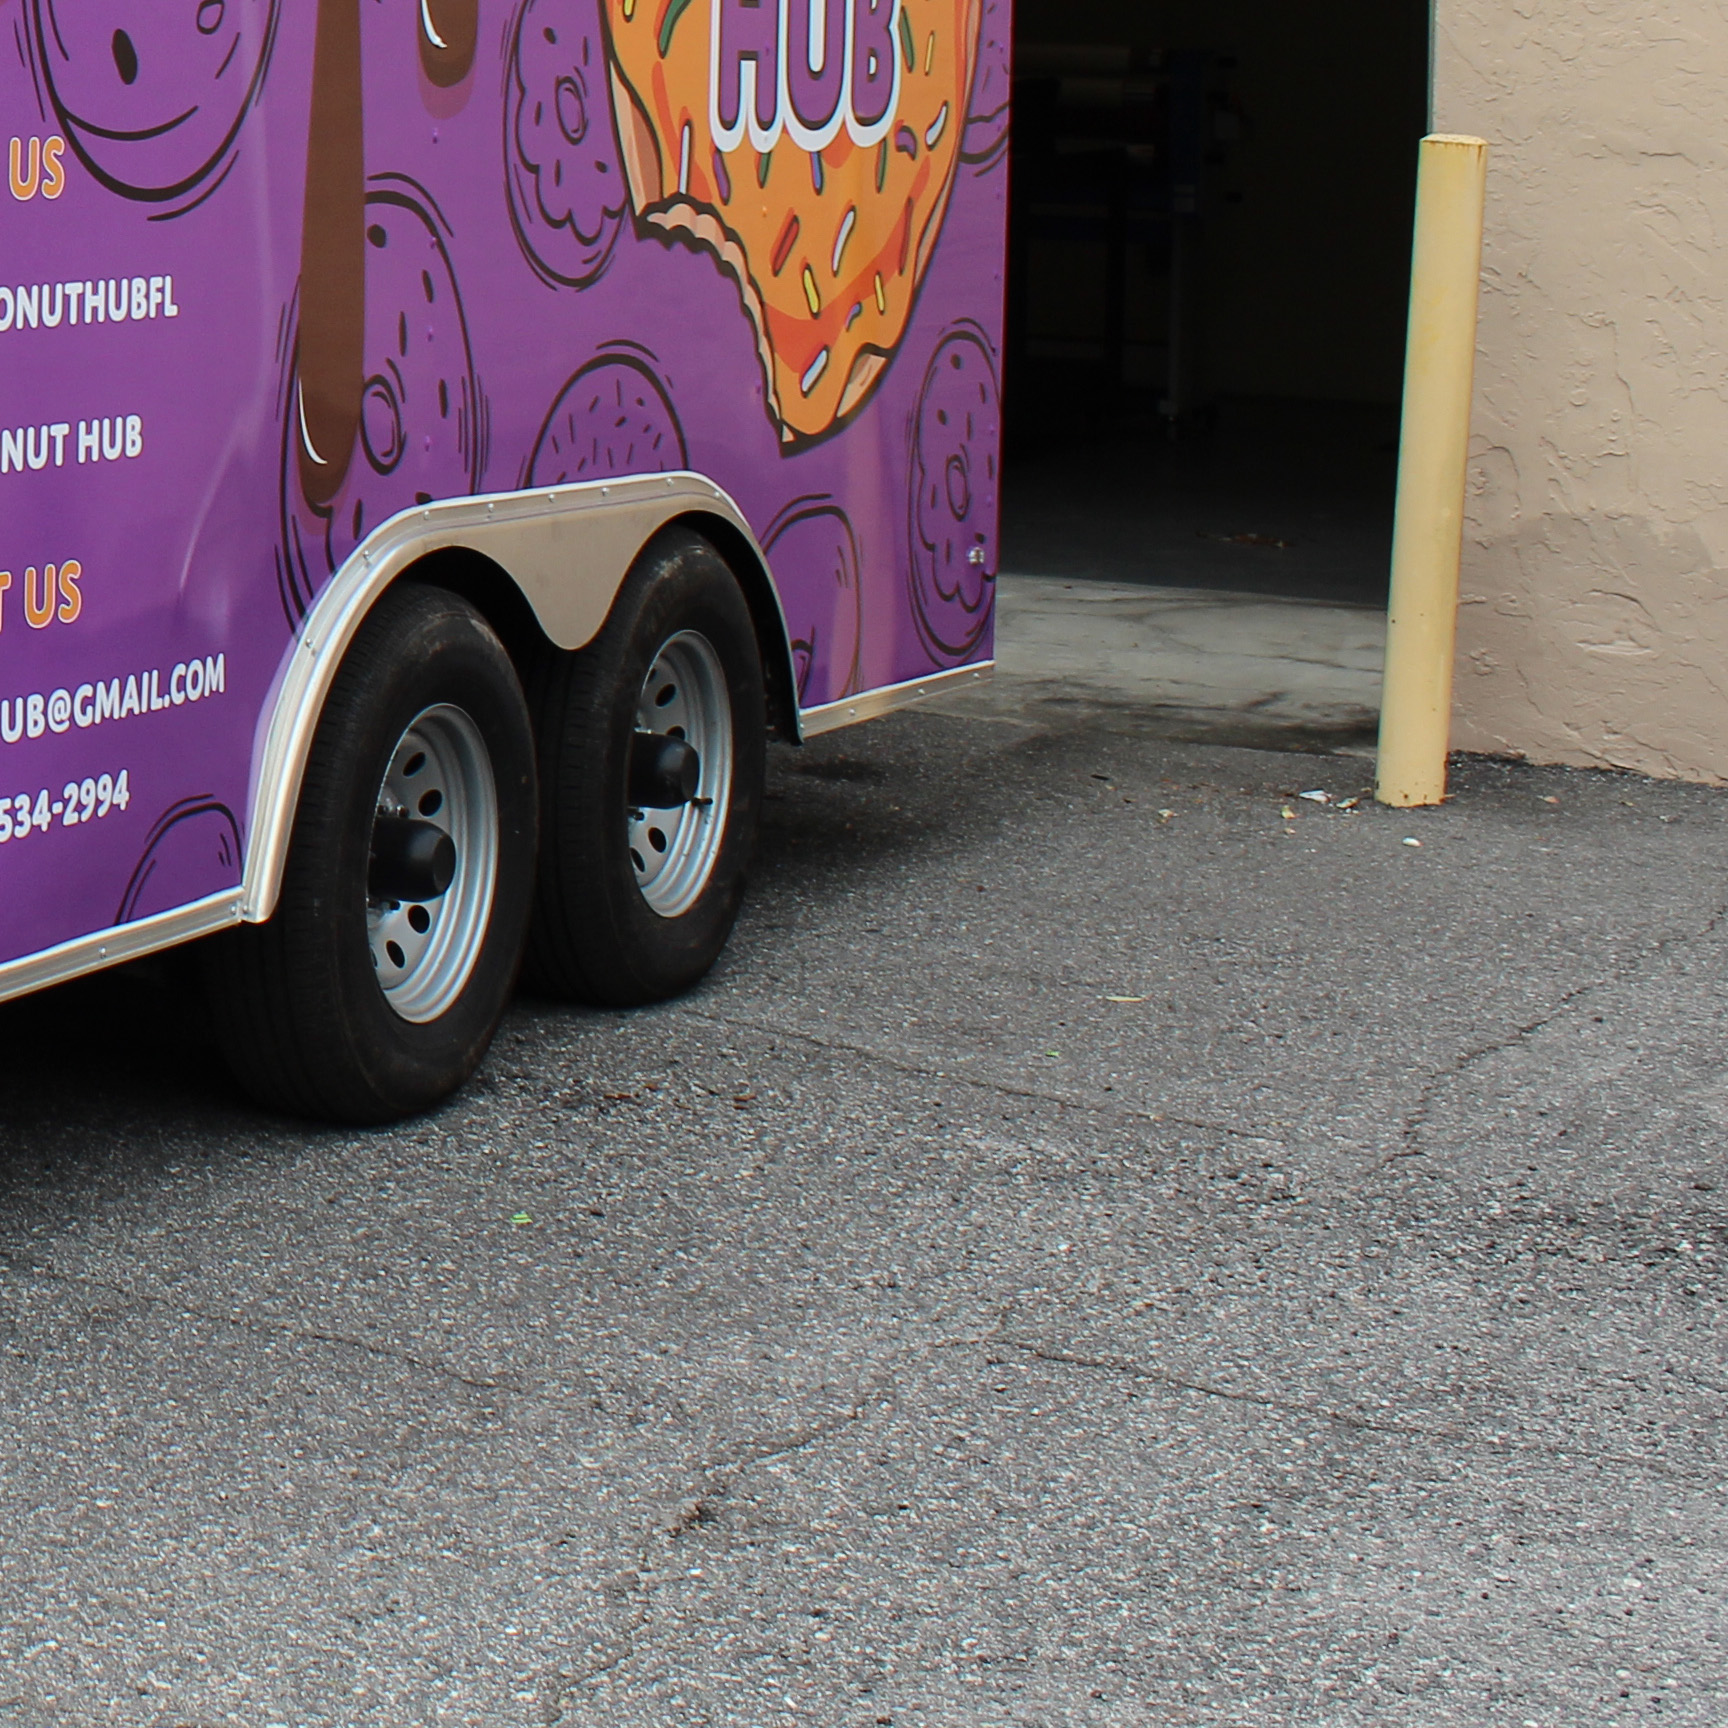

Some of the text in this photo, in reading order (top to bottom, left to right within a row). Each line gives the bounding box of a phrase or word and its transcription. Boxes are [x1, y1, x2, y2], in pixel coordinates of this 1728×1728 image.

[8, 135, 66, 201] US
[78, 414, 143, 463] HUB
[24, 559, 83, 630] US
